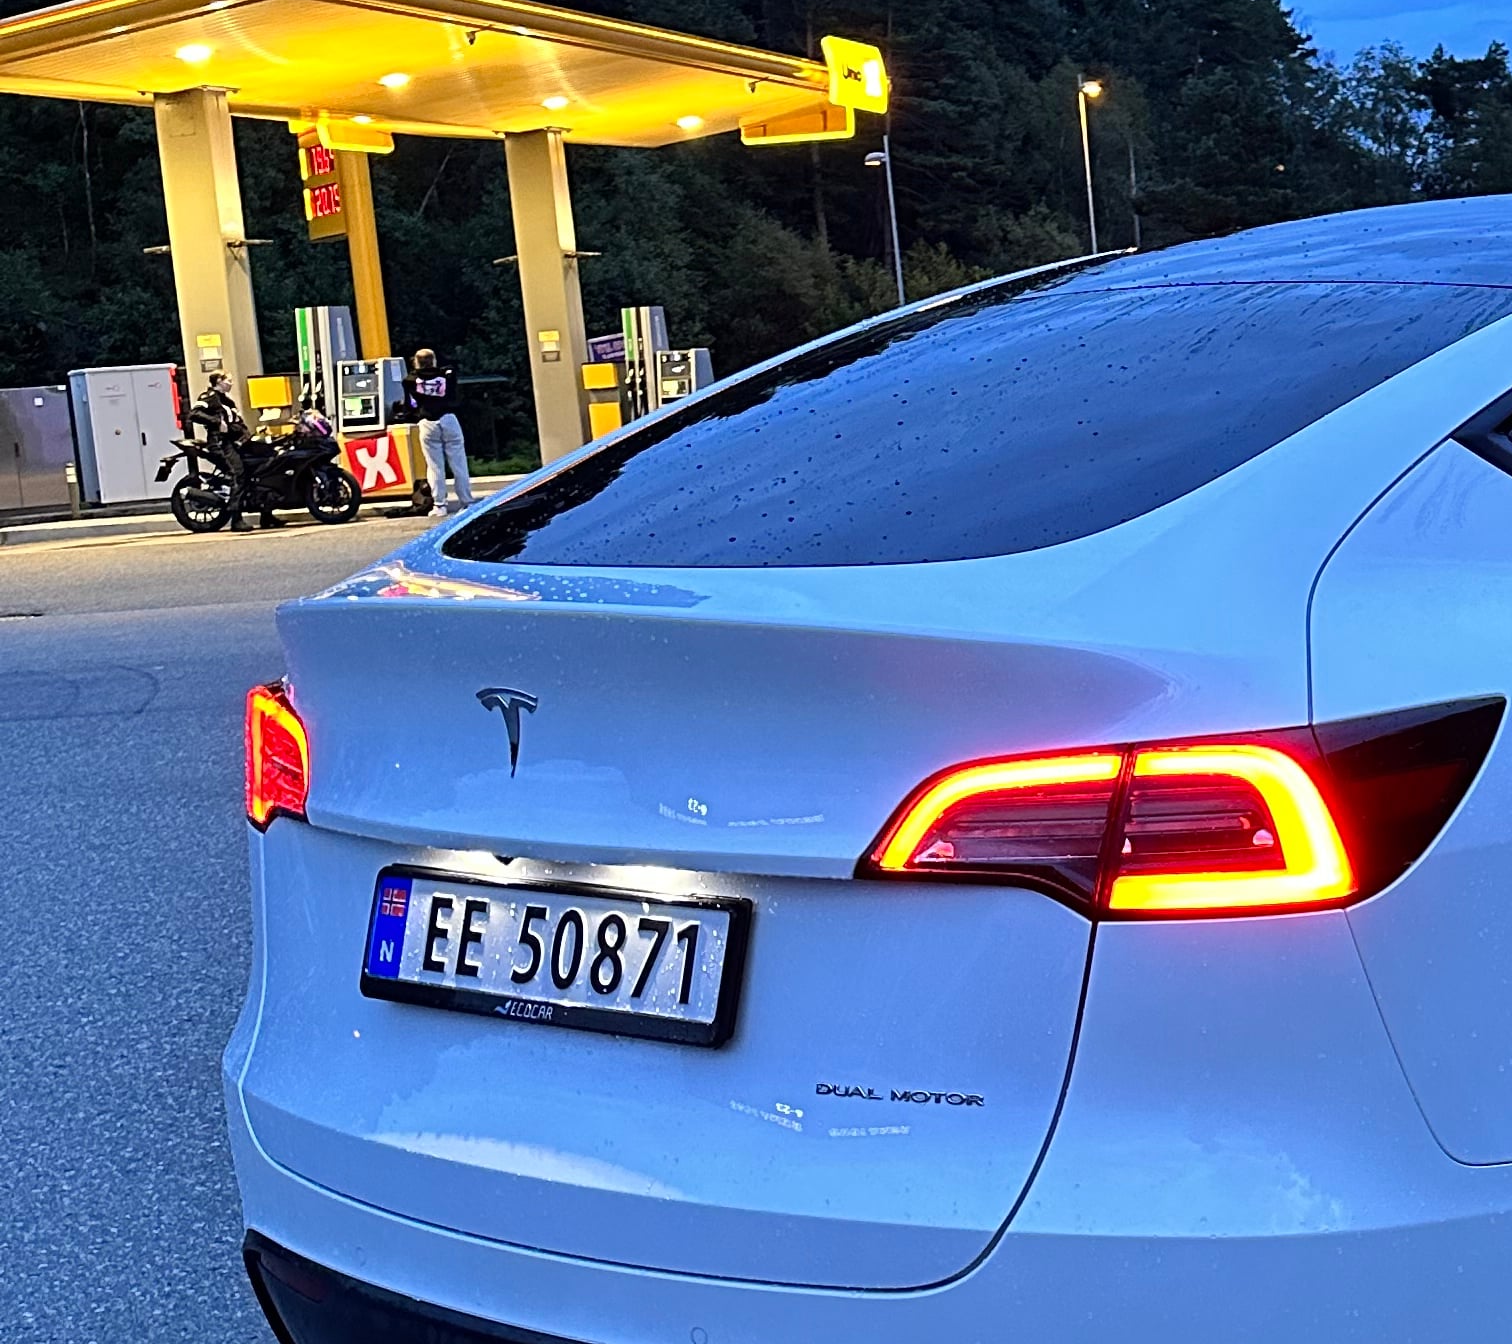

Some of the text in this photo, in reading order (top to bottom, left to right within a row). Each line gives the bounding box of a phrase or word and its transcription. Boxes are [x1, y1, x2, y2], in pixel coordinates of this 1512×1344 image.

[379, 940, 394, 963] N
[422, 893, 702, 1006] EE 50871
[510, 1001, 553, 1021] ECOCAR
[816, 1083, 985, 1107] DUAL MOTOR
